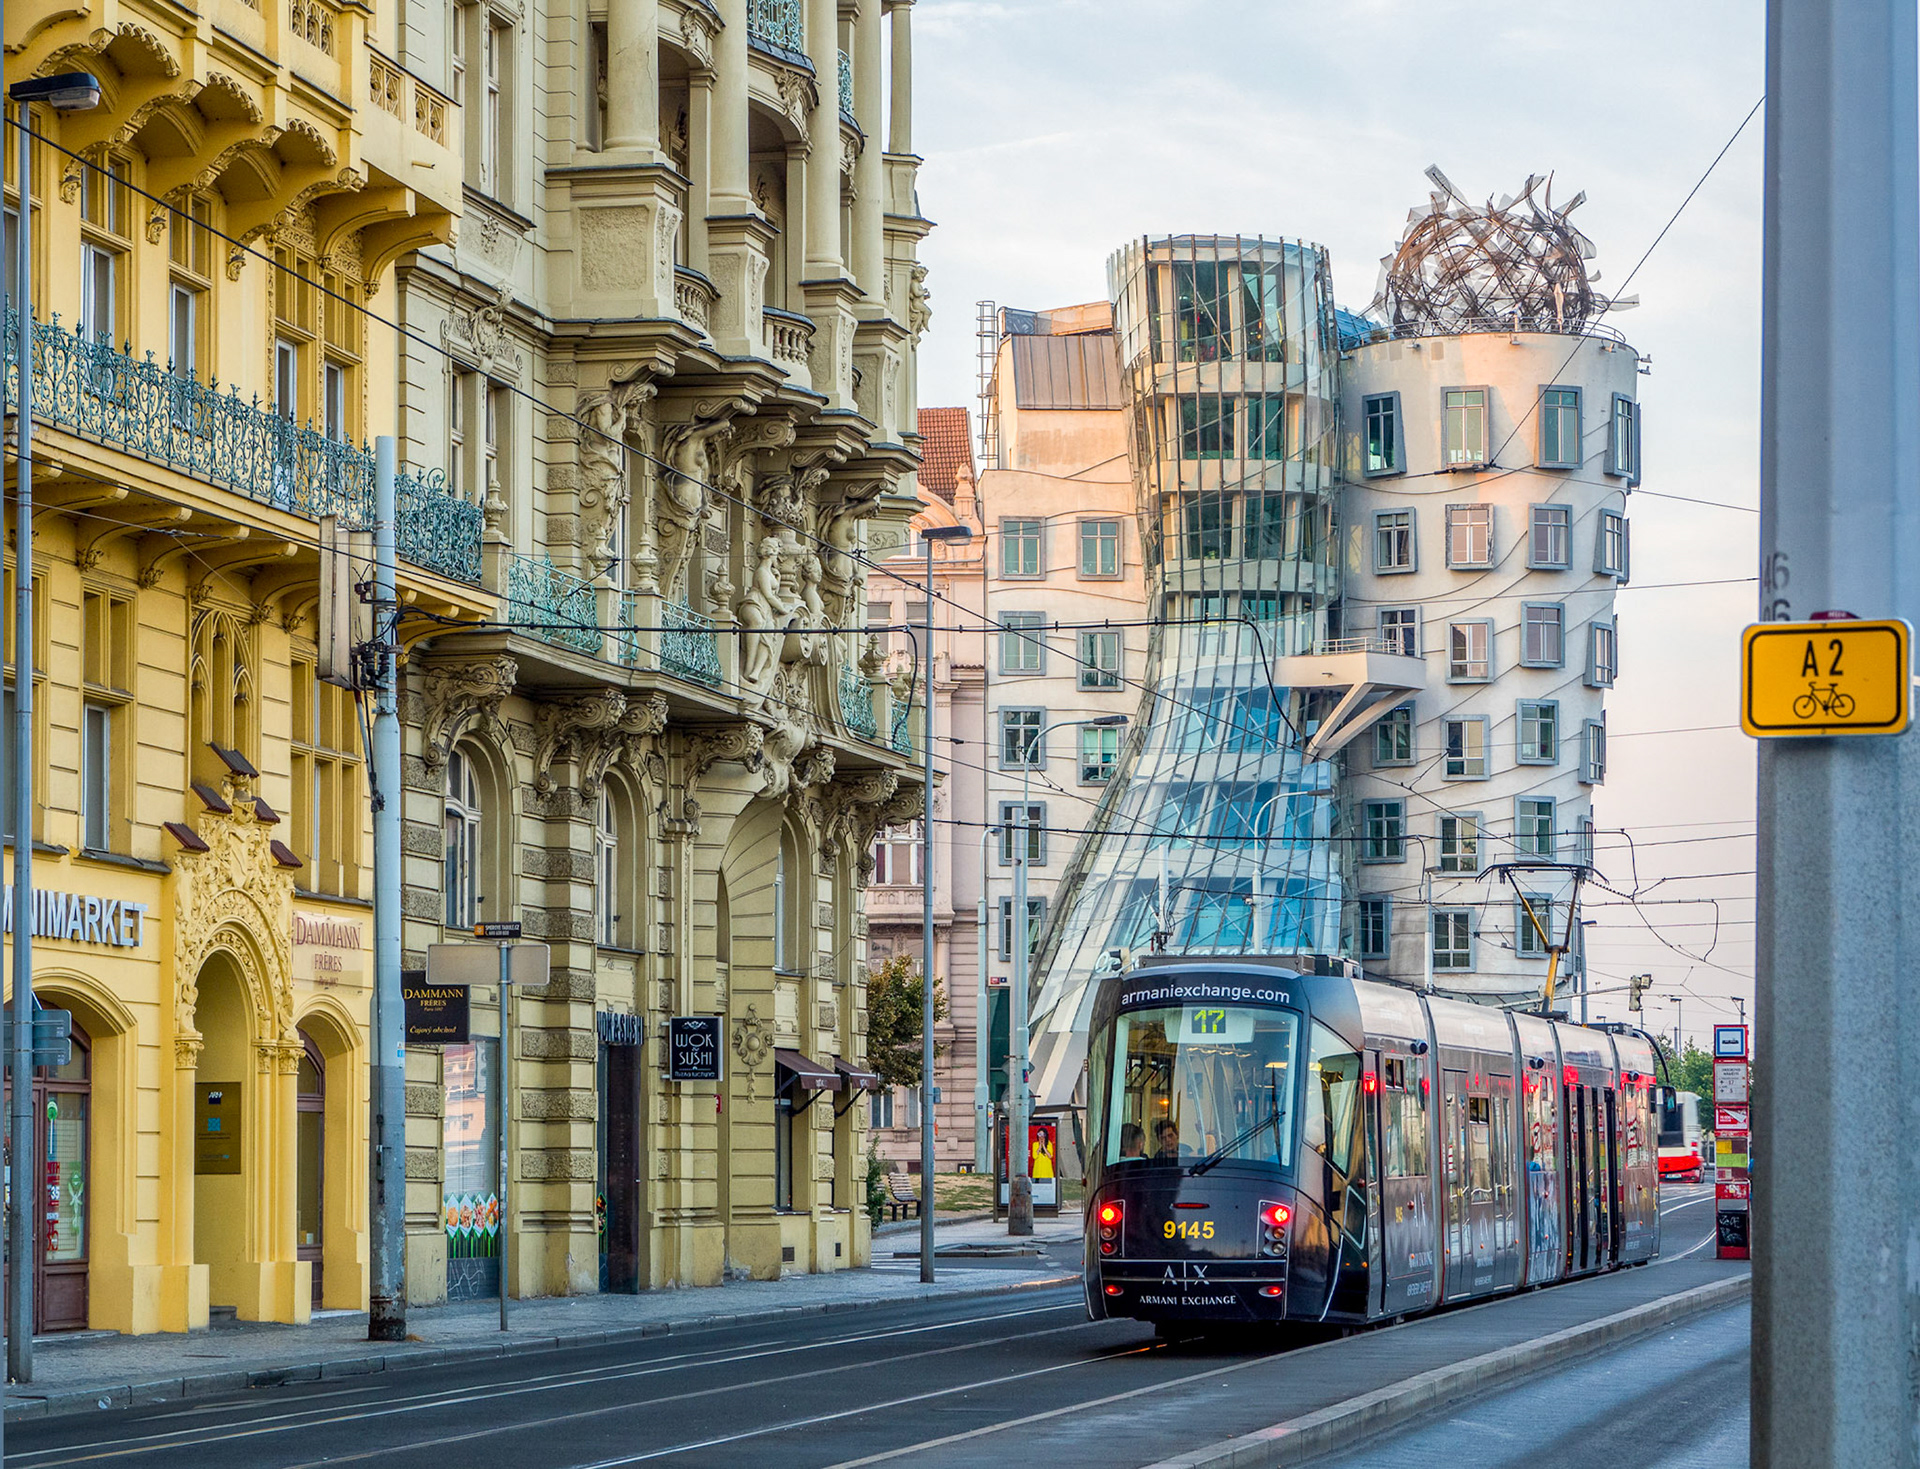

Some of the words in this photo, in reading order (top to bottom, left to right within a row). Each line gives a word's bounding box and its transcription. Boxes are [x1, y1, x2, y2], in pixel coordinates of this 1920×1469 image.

[3, 884, 149, 948] MNIMARKET
[296, 916, 361, 950] DAMMANN
[403, 988, 464, 1000] DAMMANN
[1120, 983, 1291, 1006] armaniexchange.com
[1193, 1009, 1226, 1034] 17
[675, 1033, 714, 1048] WOK
[678, 1051, 712, 1066] SUSHI
[1163, 1220, 1215, 1240] 9145
[1139, 1295, 1178, 1306] ARMANI
[1181, 1294, 1237, 1306] EXCHANGE
